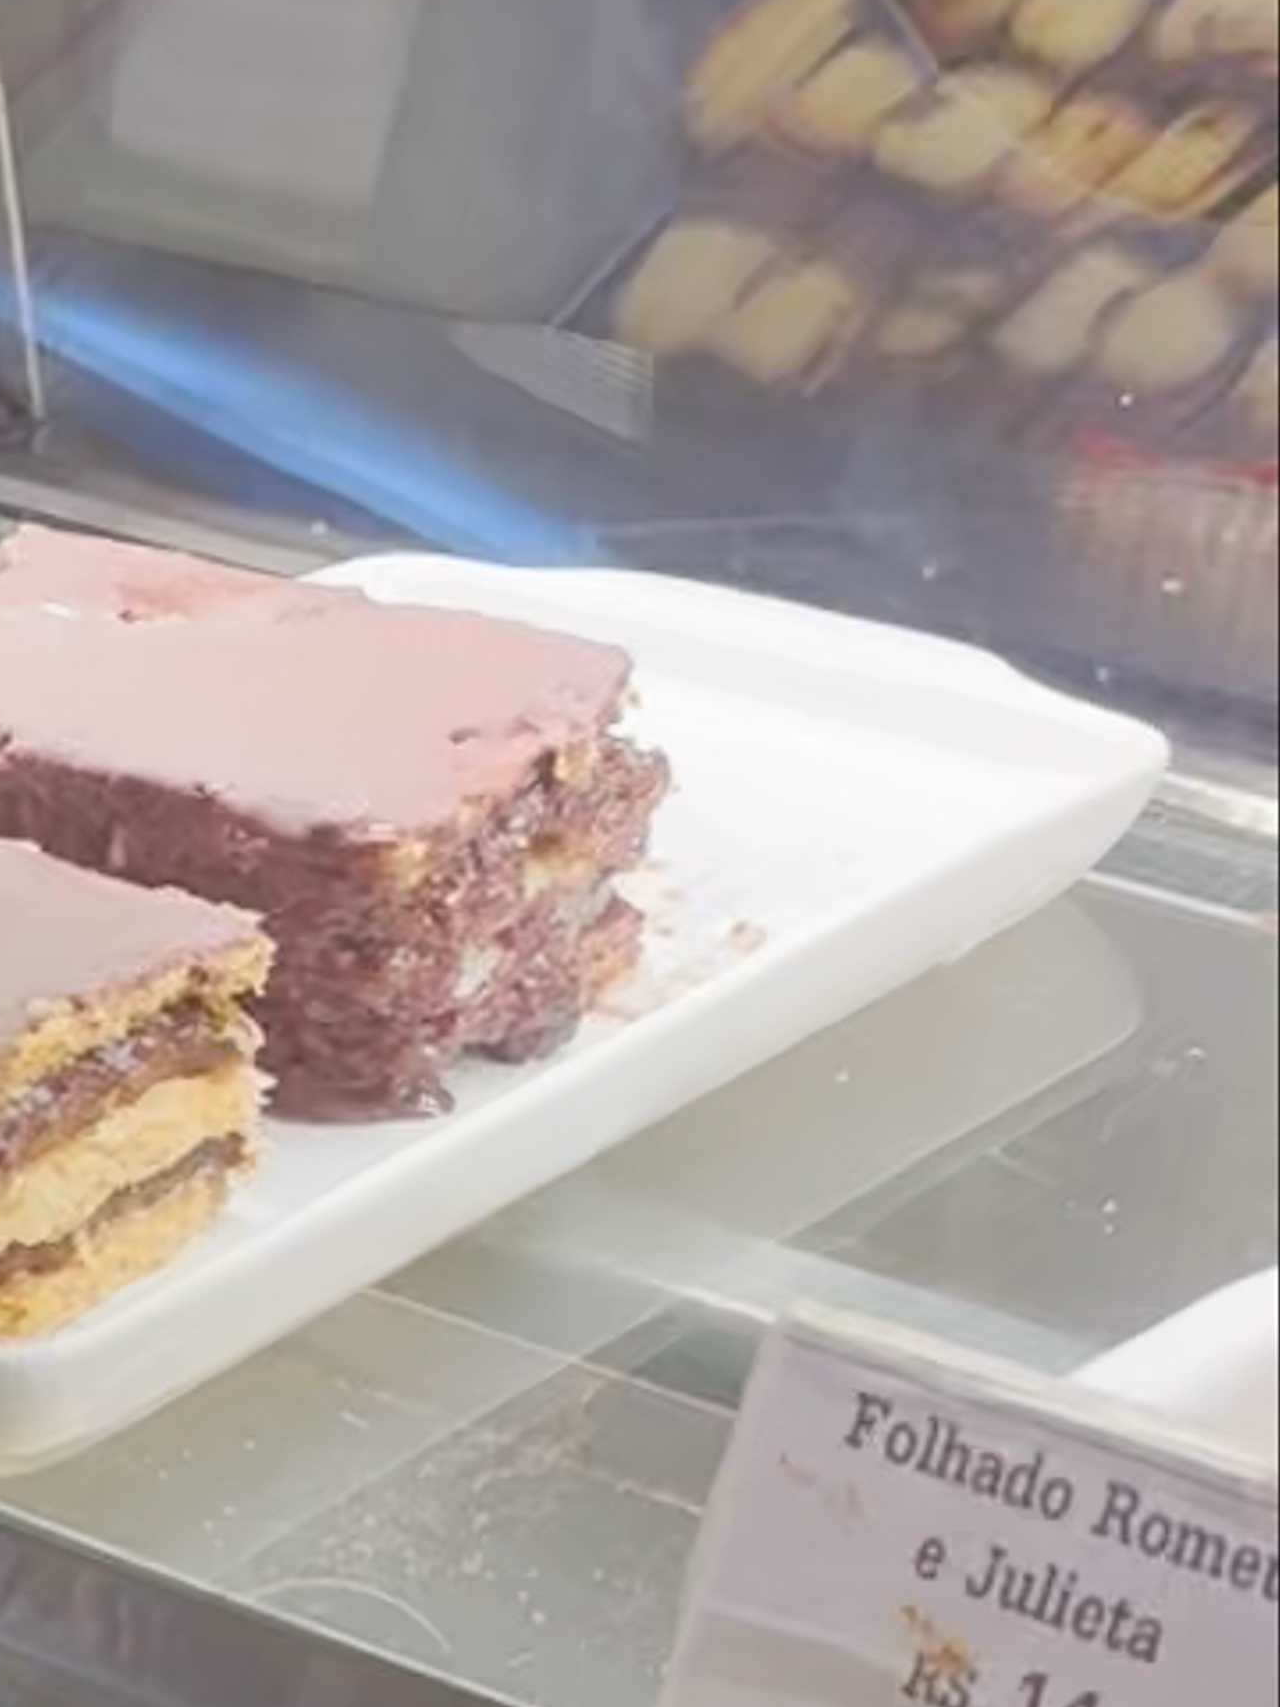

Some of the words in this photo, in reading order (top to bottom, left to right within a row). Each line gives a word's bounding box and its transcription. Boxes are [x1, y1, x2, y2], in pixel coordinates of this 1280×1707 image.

[844, 1393, 1073, 1520] Folhado
[915, 1537, 946, 1579] e
[965, 1547, 1162, 1663] Julieta
